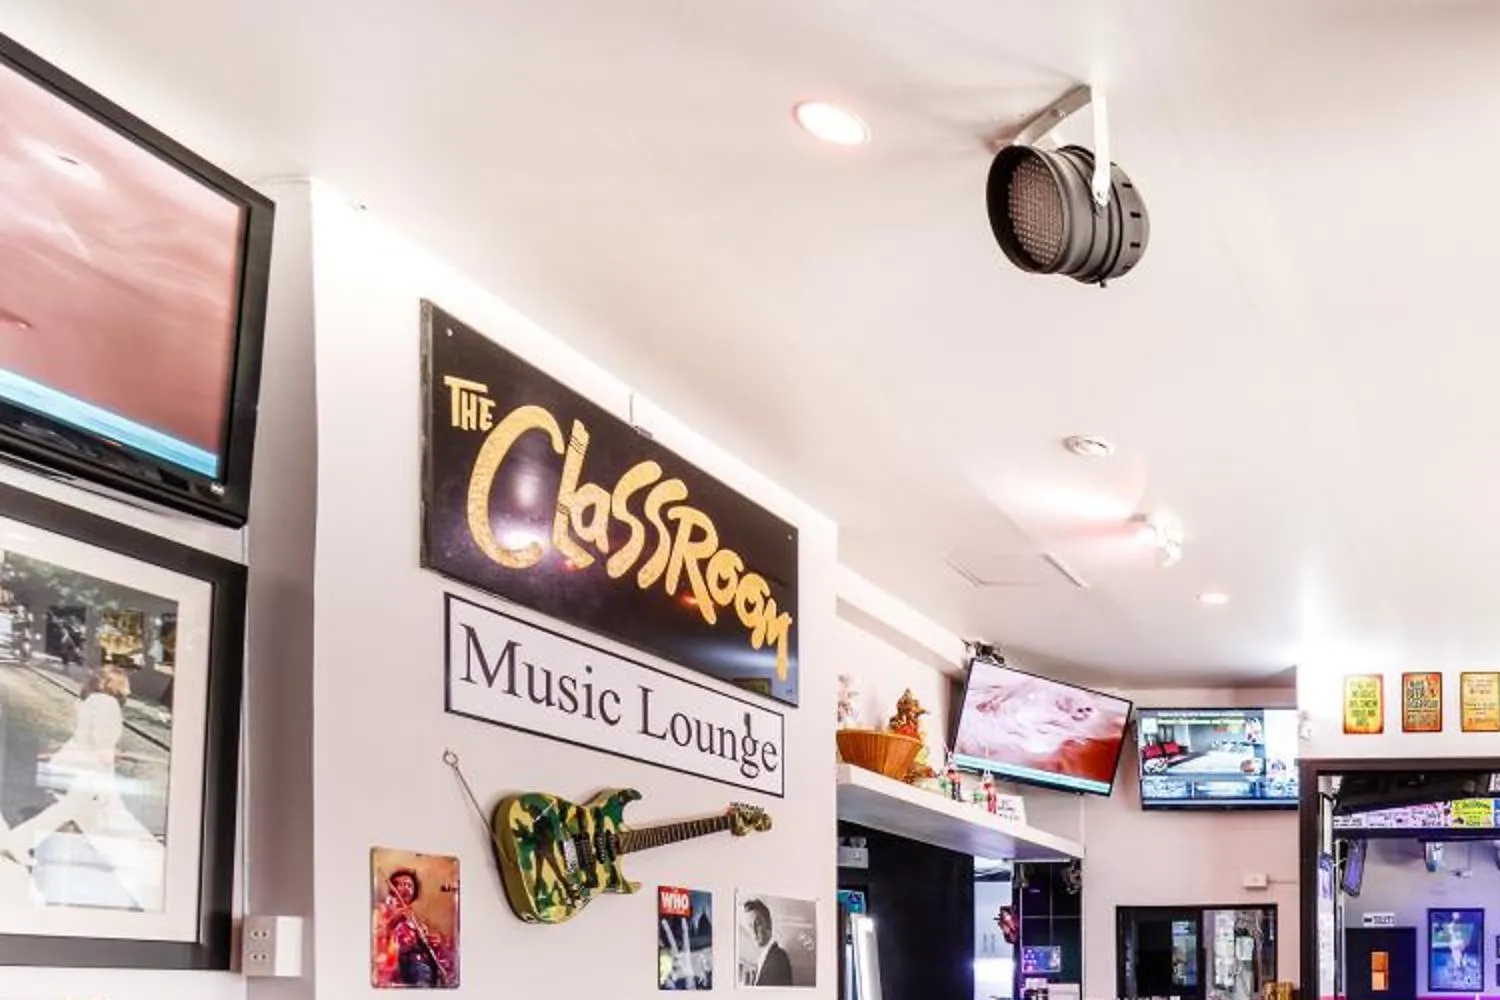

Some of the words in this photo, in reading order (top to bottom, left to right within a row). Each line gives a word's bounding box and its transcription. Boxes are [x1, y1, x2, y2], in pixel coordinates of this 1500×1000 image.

[443, 375, 496, 432] THE
[460, 623, 622, 727] Music
[638, 685, 778, 779] Lounge
[661, 891, 690, 910] WHO
